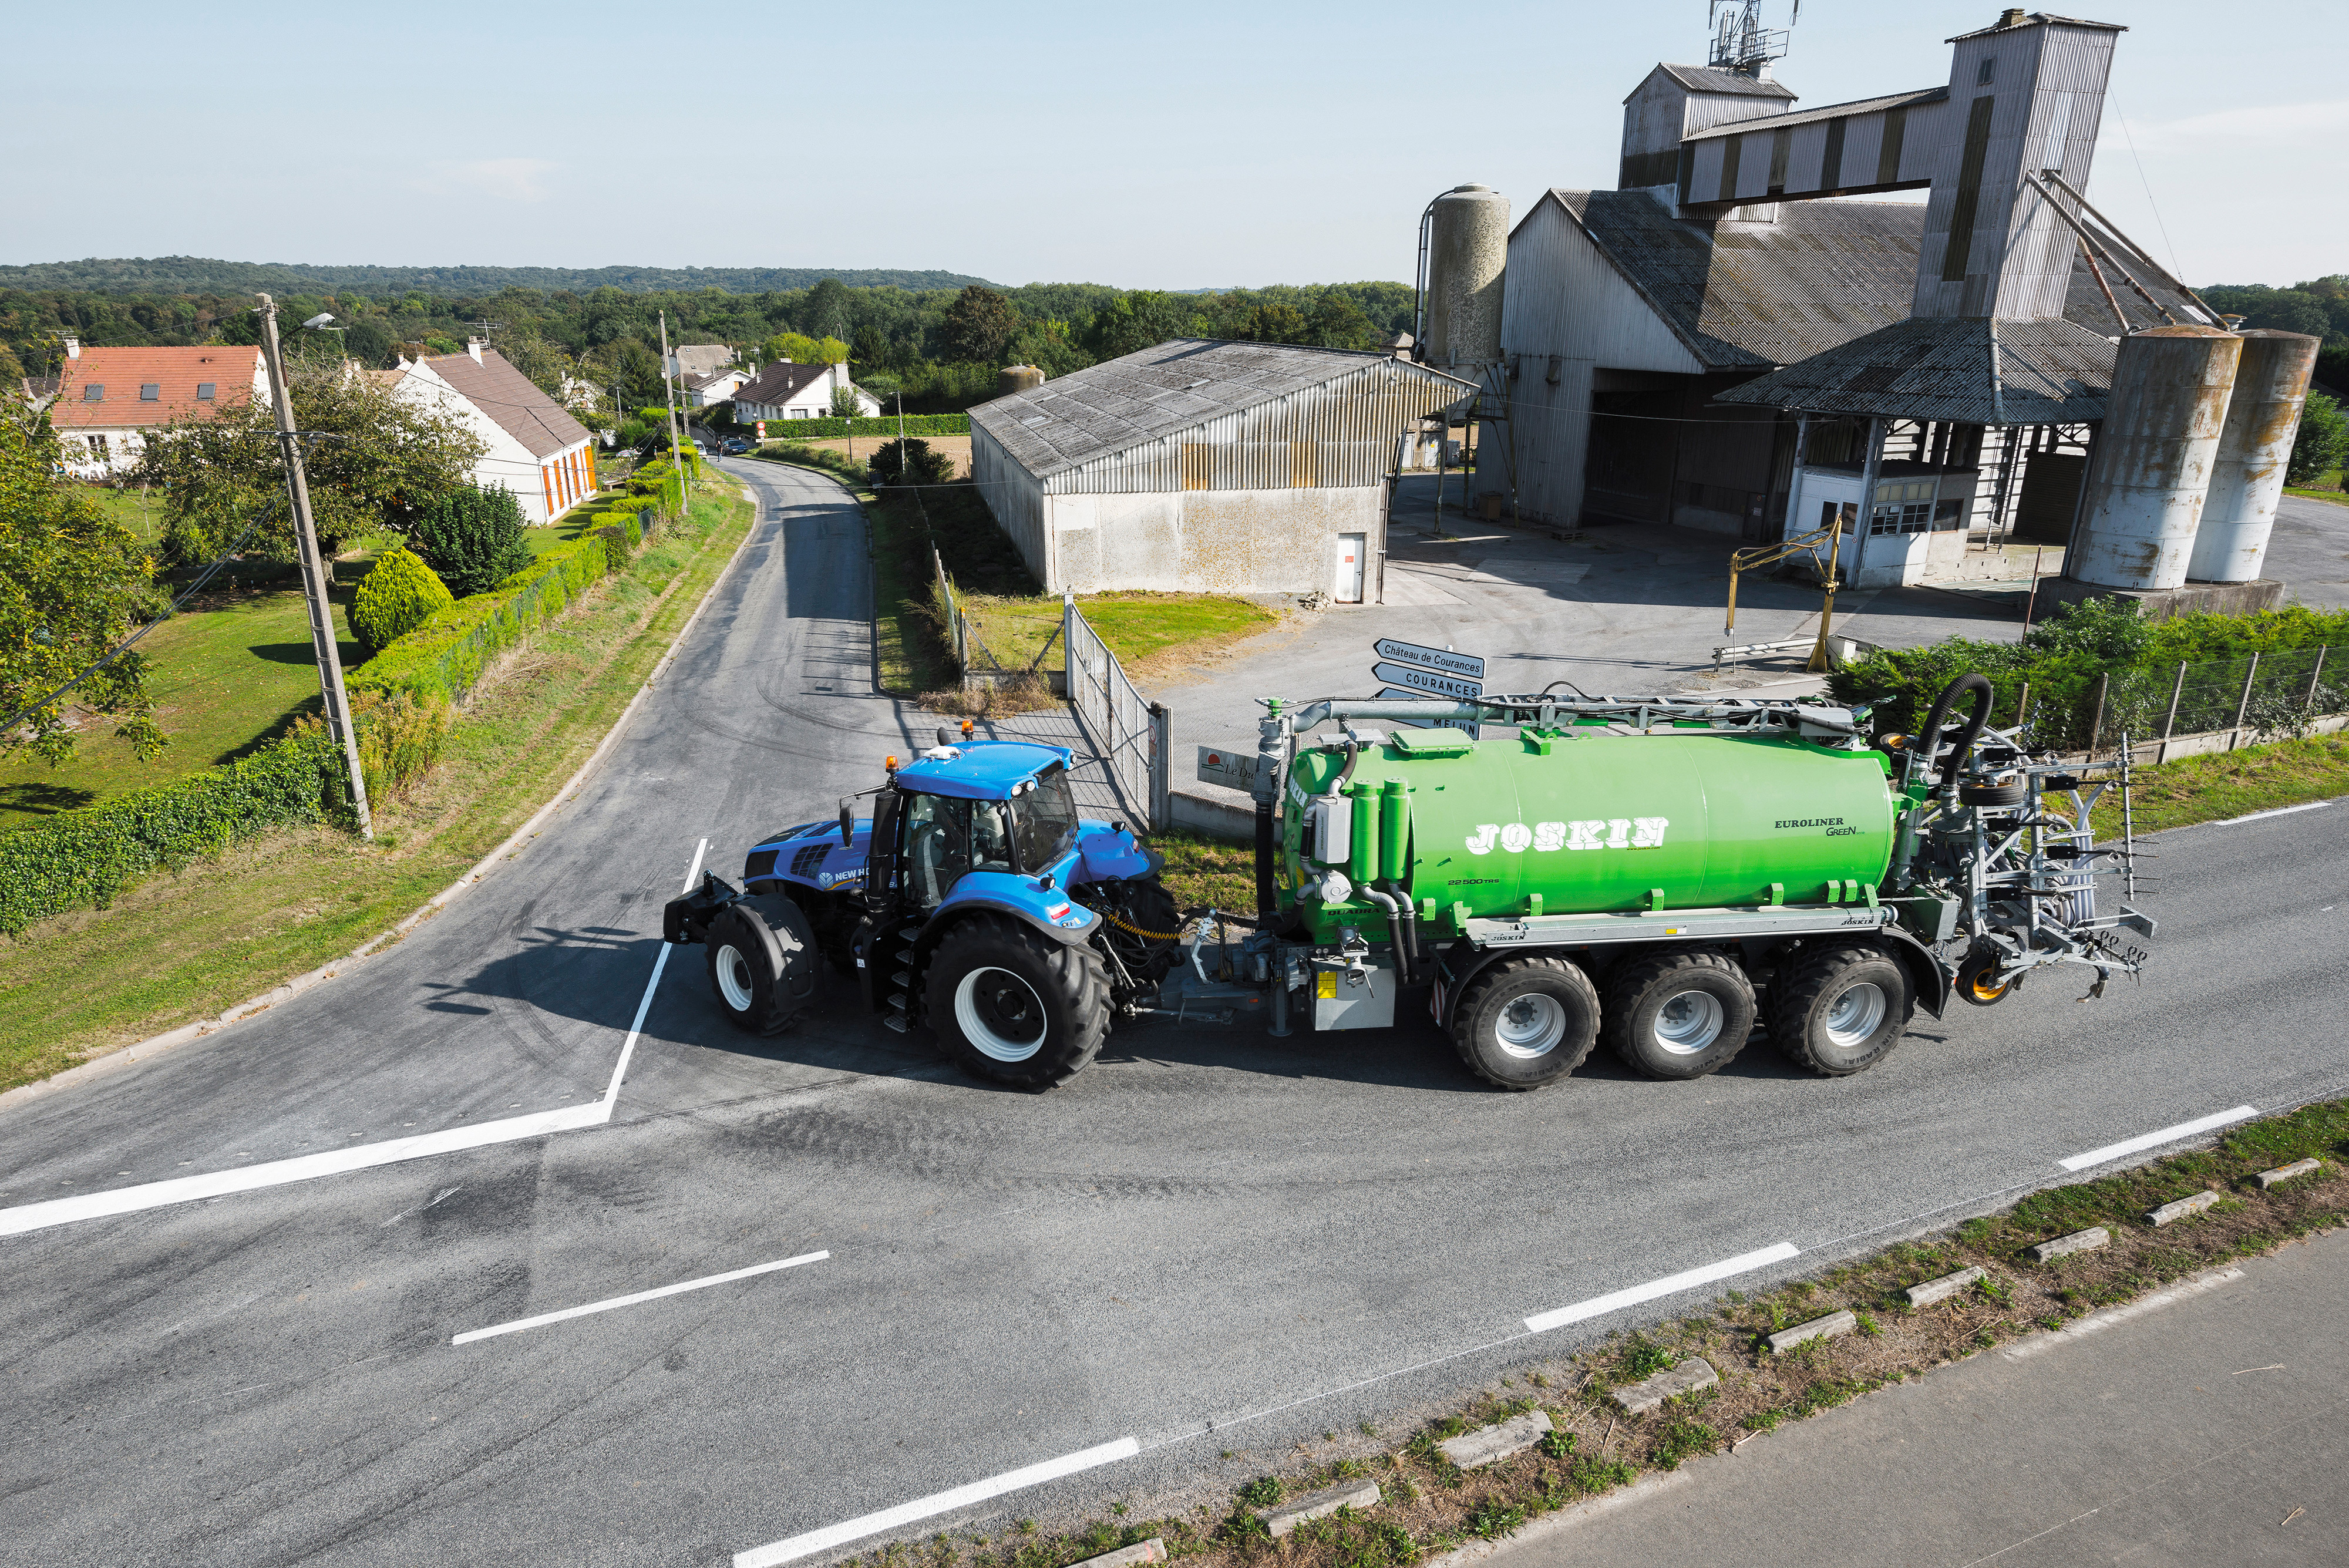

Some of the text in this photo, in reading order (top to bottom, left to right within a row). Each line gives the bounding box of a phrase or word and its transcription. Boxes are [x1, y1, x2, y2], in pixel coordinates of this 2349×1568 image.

[1385, 645, 1480, 673] Château de Courances
[1406, 673, 1478, 697] COURANCES
[1225, 764, 1256, 780] Le Du
[1775, 817, 1844, 829] EUROLINER
[1465, 817, 1669, 855] JOSKIN
[835, 870, 856, 881] NEW
[1328, 908, 1381, 916] QUADRA
[1843, 1019, 1902, 1065] TWIN RADIAL
[1691, 1055, 1722, 1072] TWIN
